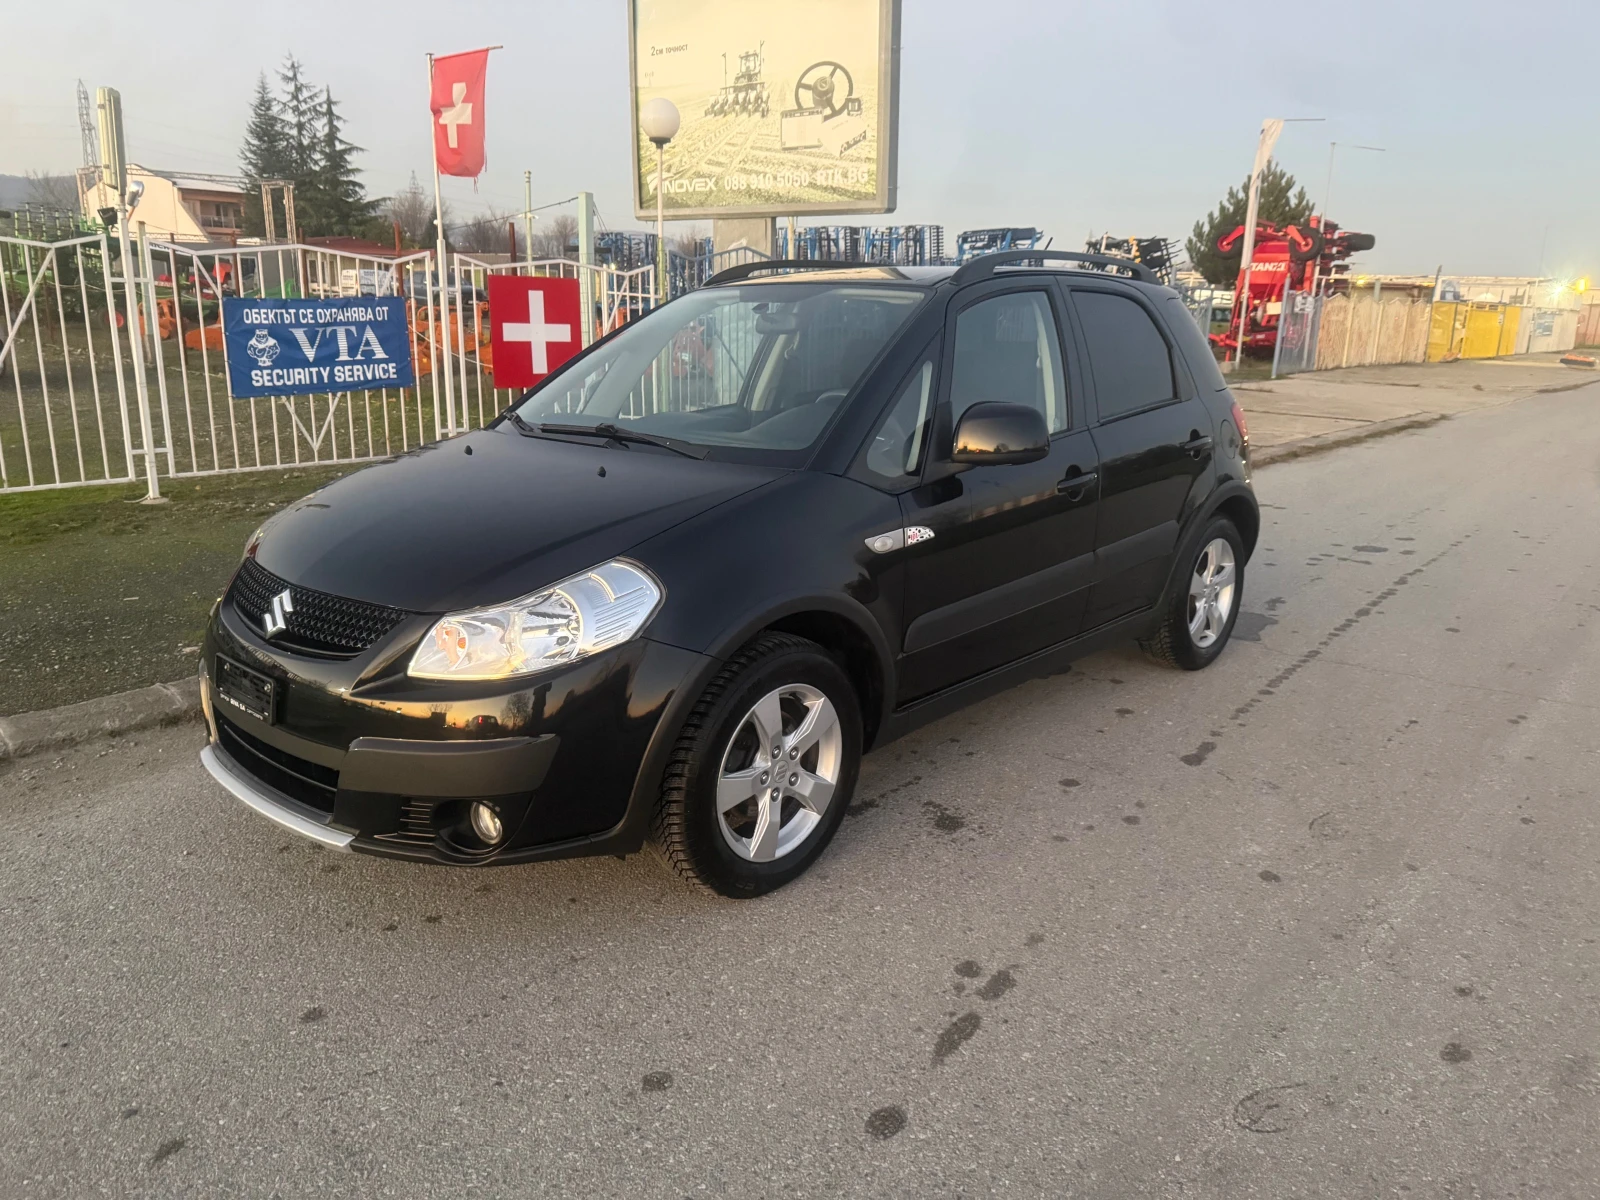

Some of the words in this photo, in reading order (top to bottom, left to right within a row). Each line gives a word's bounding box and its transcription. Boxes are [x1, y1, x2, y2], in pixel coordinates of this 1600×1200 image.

[724, 175, 747, 190] 088
[776, 171, 809, 189] 5050
[243, 308, 297, 324] ОБЕКТЪТ
[299, 308, 315, 323] СЕ
[317, 307, 374, 323] ОХРАНЯВА
[376, 306, 389, 321] ОТ
[288, 324, 389, 363] VTA
[251, 366, 330, 387] SECURITY
[334, 362, 398, 382] SERVICE
